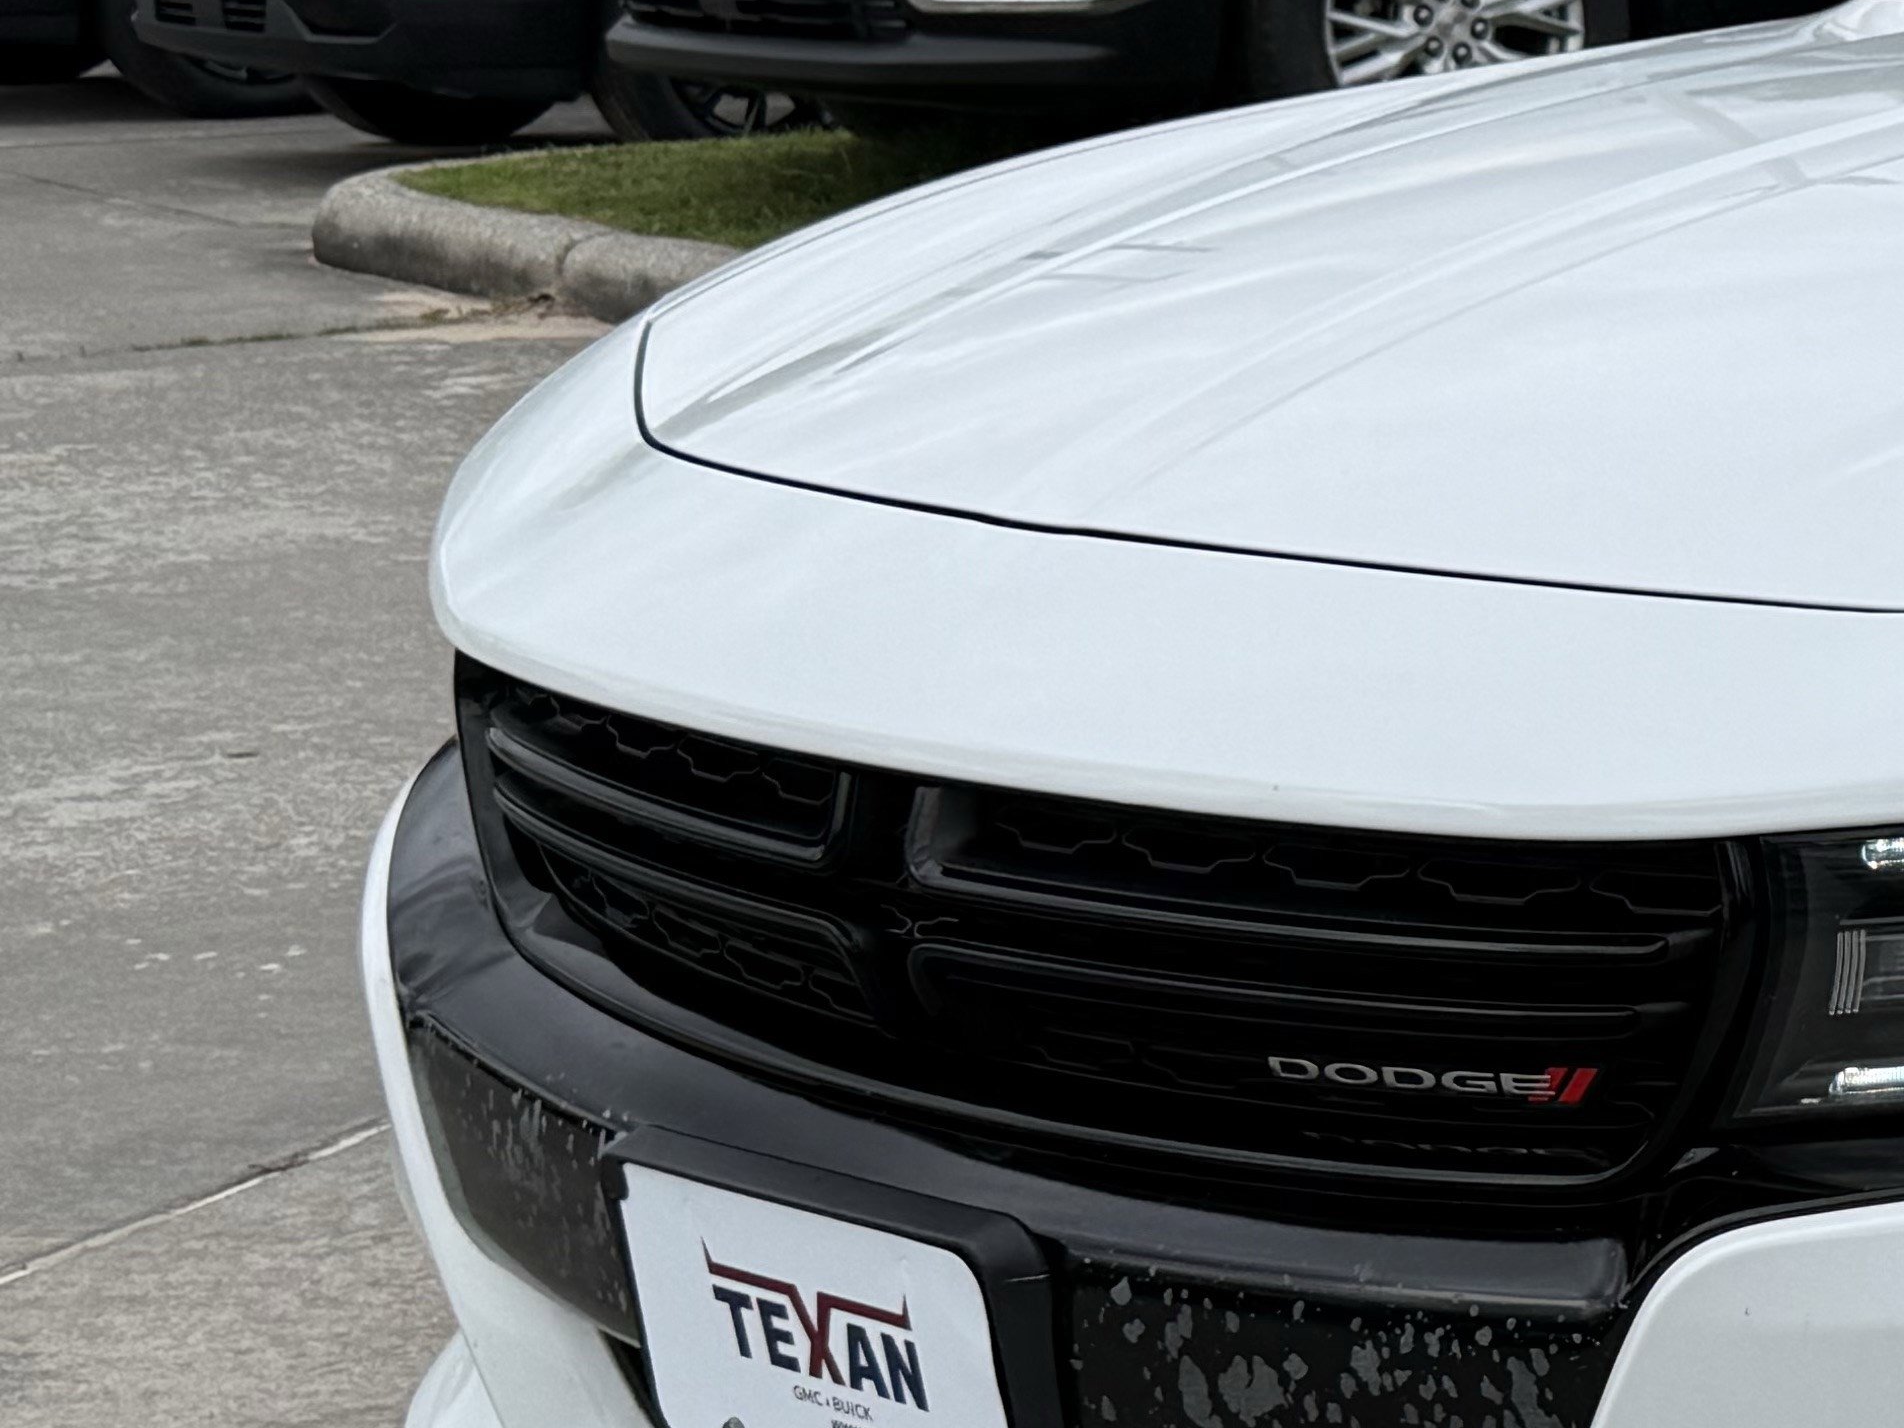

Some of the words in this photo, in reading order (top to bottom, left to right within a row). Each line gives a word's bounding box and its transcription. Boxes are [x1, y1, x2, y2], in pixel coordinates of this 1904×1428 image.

[1268, 1056, 1555, 1095] DODGE
[701, 1236, 930, 1413] TEXAN
[793, 1384, 823, 1407] GMC
[832, 1396, 873, 1421] BUICK
